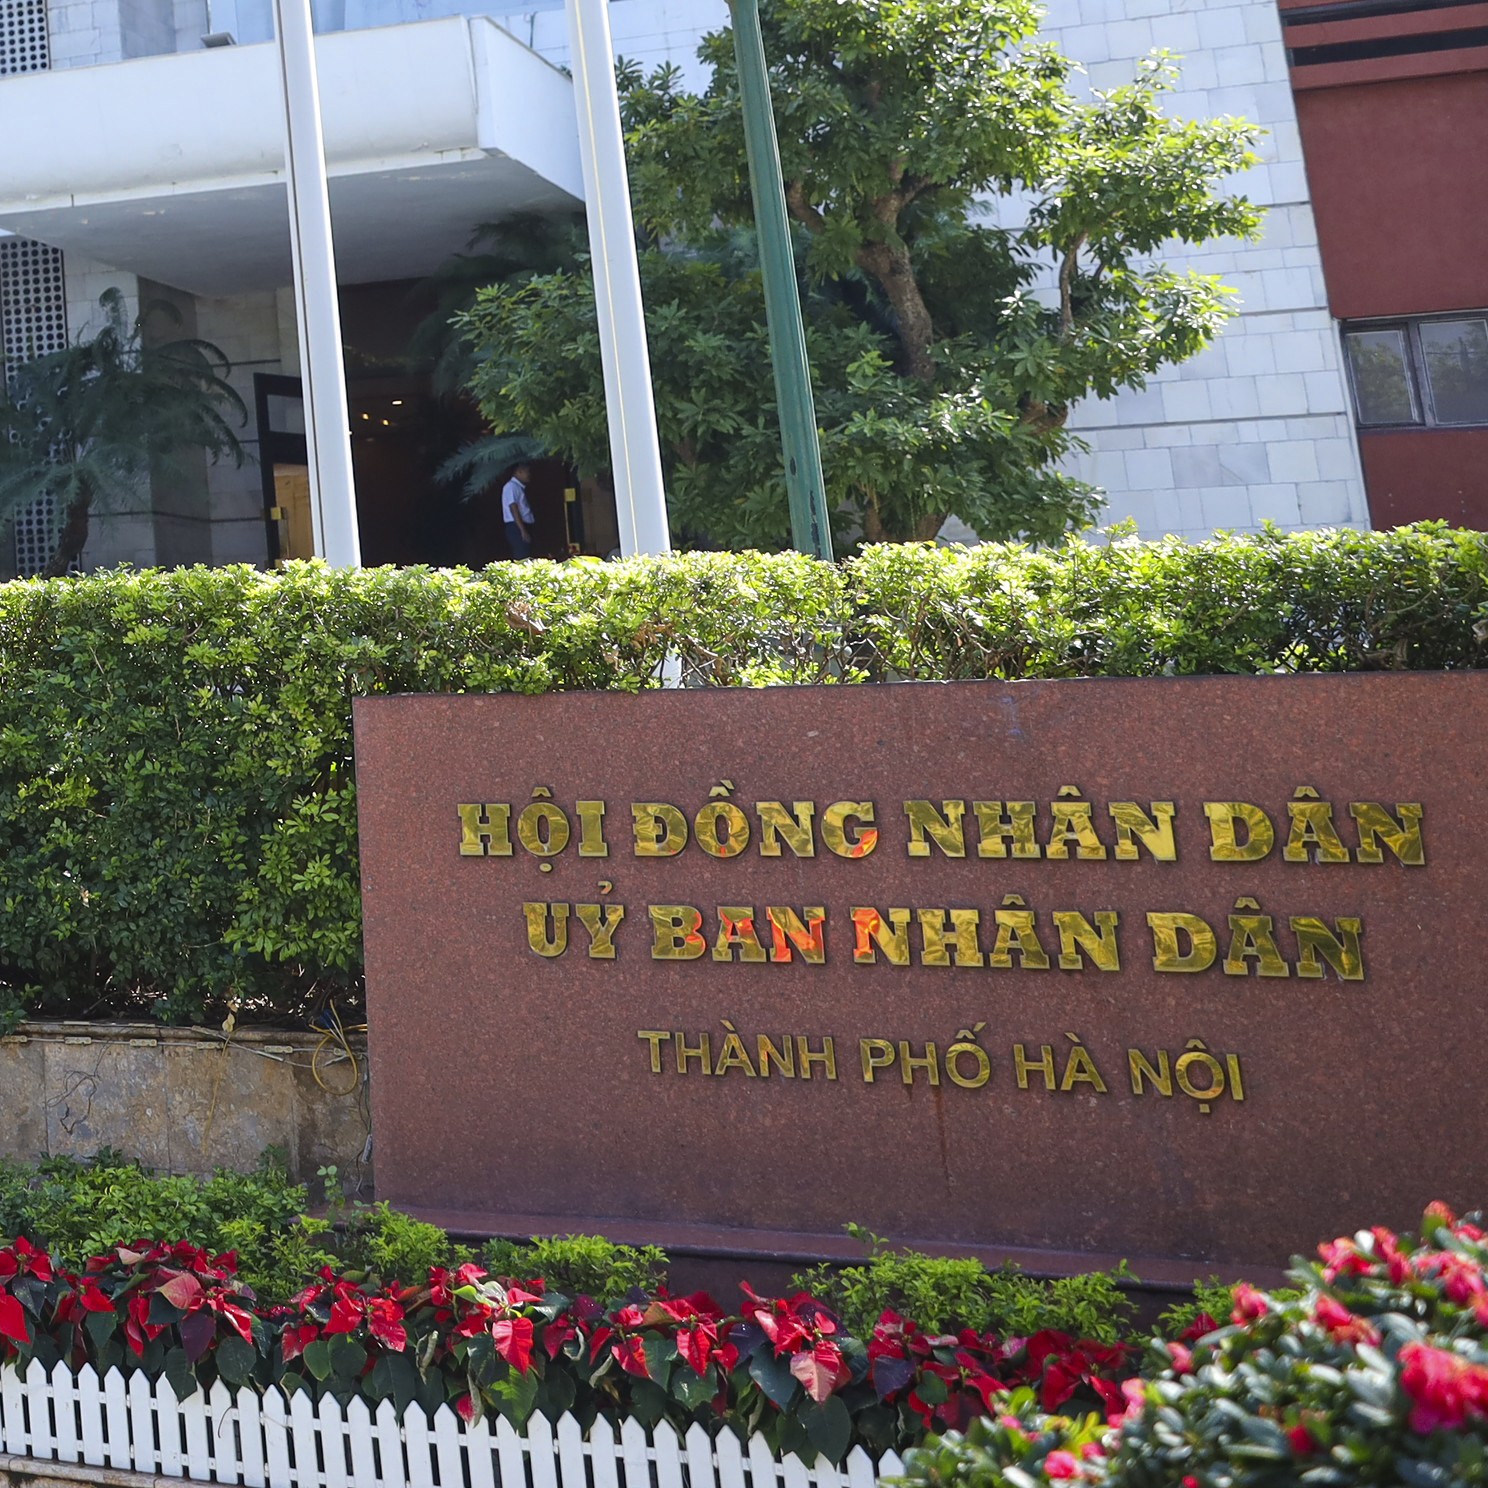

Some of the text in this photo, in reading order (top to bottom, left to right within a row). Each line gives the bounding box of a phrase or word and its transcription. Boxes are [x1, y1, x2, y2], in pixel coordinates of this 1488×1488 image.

[457, 779, 1426, 873] HỘI ĐỒNG NHÂN DÂN
[647, 904, 826, 965] BAN
[849, 893, 1121, 972] NHÂN
[1145, 896, 1365, 981] DÂN
[637, 1019, 1245, 1114] THÀNH PHỐ HÀ NỘI
